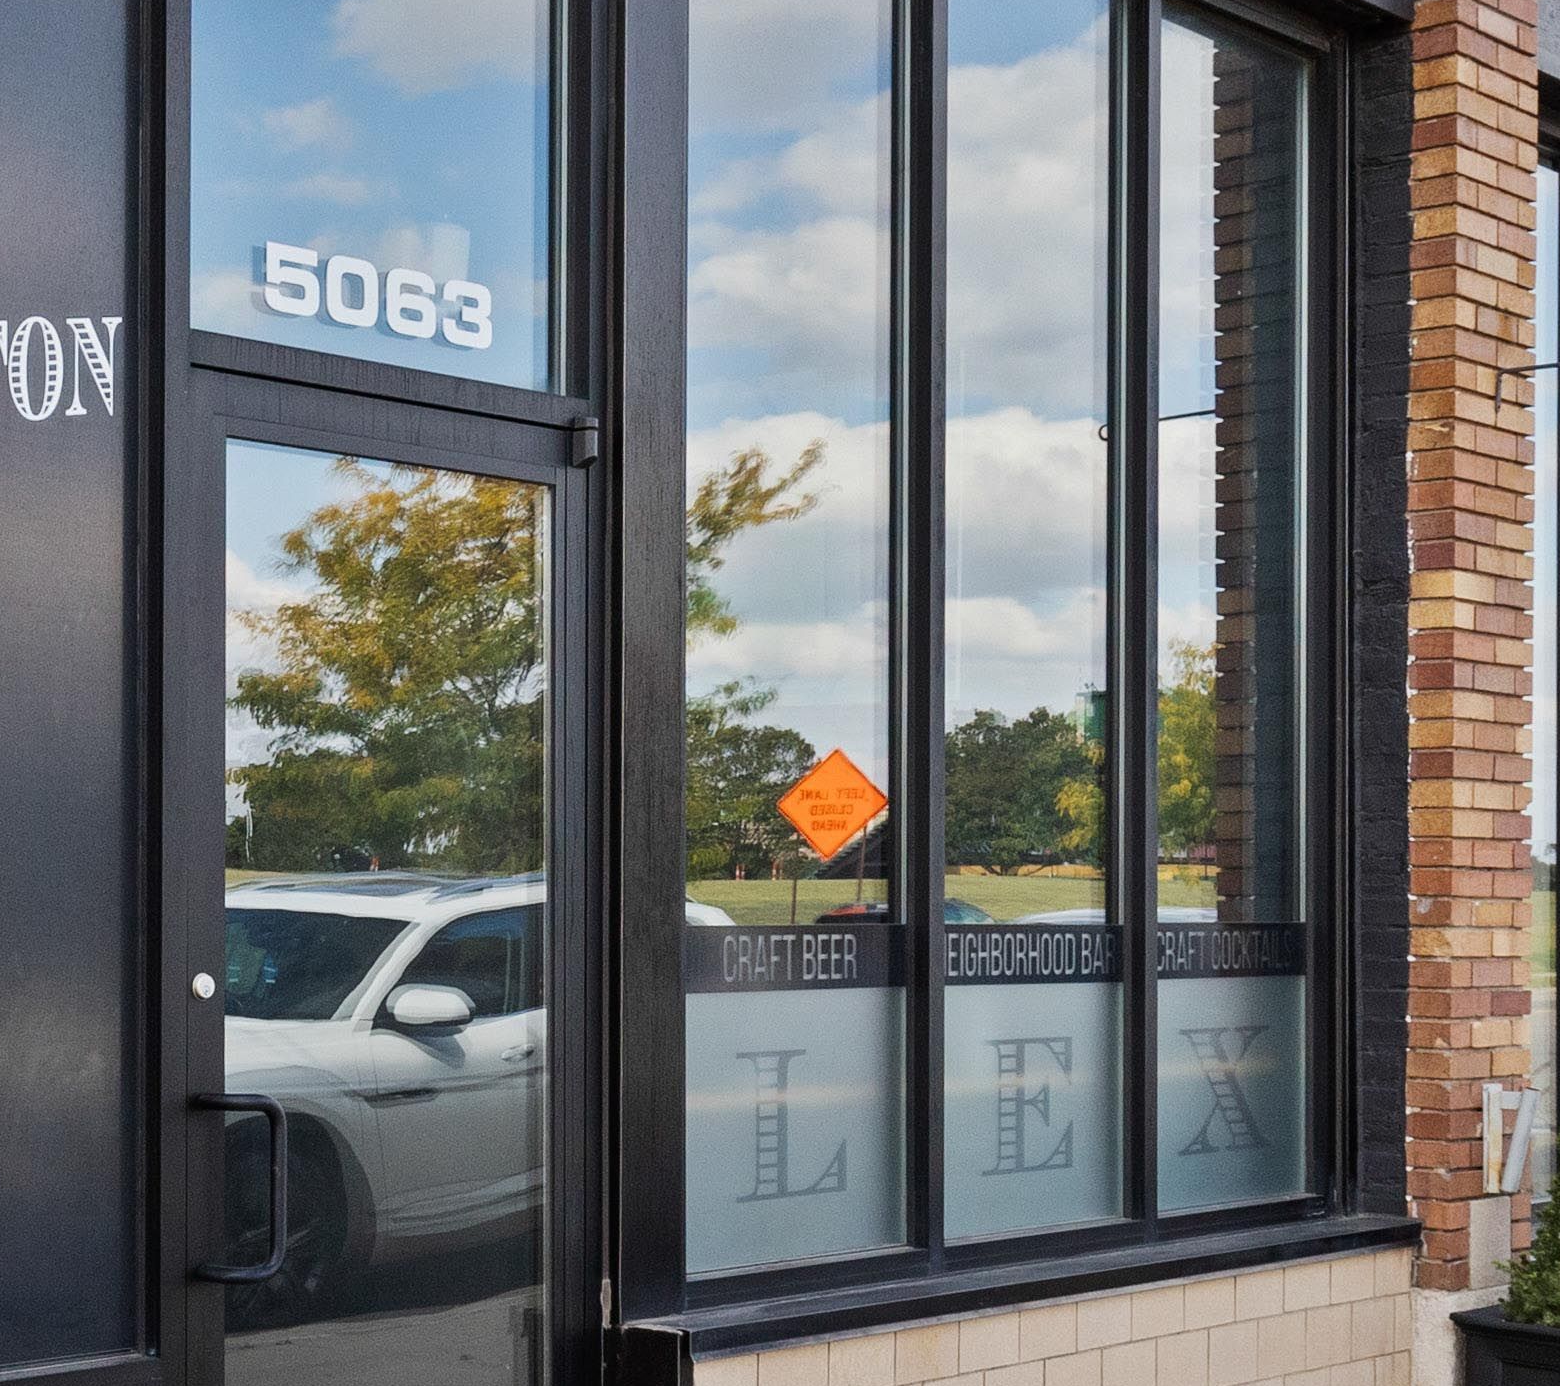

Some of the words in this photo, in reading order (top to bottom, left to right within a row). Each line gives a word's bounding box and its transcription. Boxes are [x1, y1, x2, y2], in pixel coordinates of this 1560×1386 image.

[263, 240, 494, 351] 5063
[722, 933, 797, 983] CRAFT
[802, 932, 858, 982] BEER
[944, 932, 1077, 978] EIGHBORHOOD
[1081, 931, 1116, 976] BAR
[1156, 930, 1206, 972] CRAFT
[1210, 929, 1293, 971] COCKTAILS
